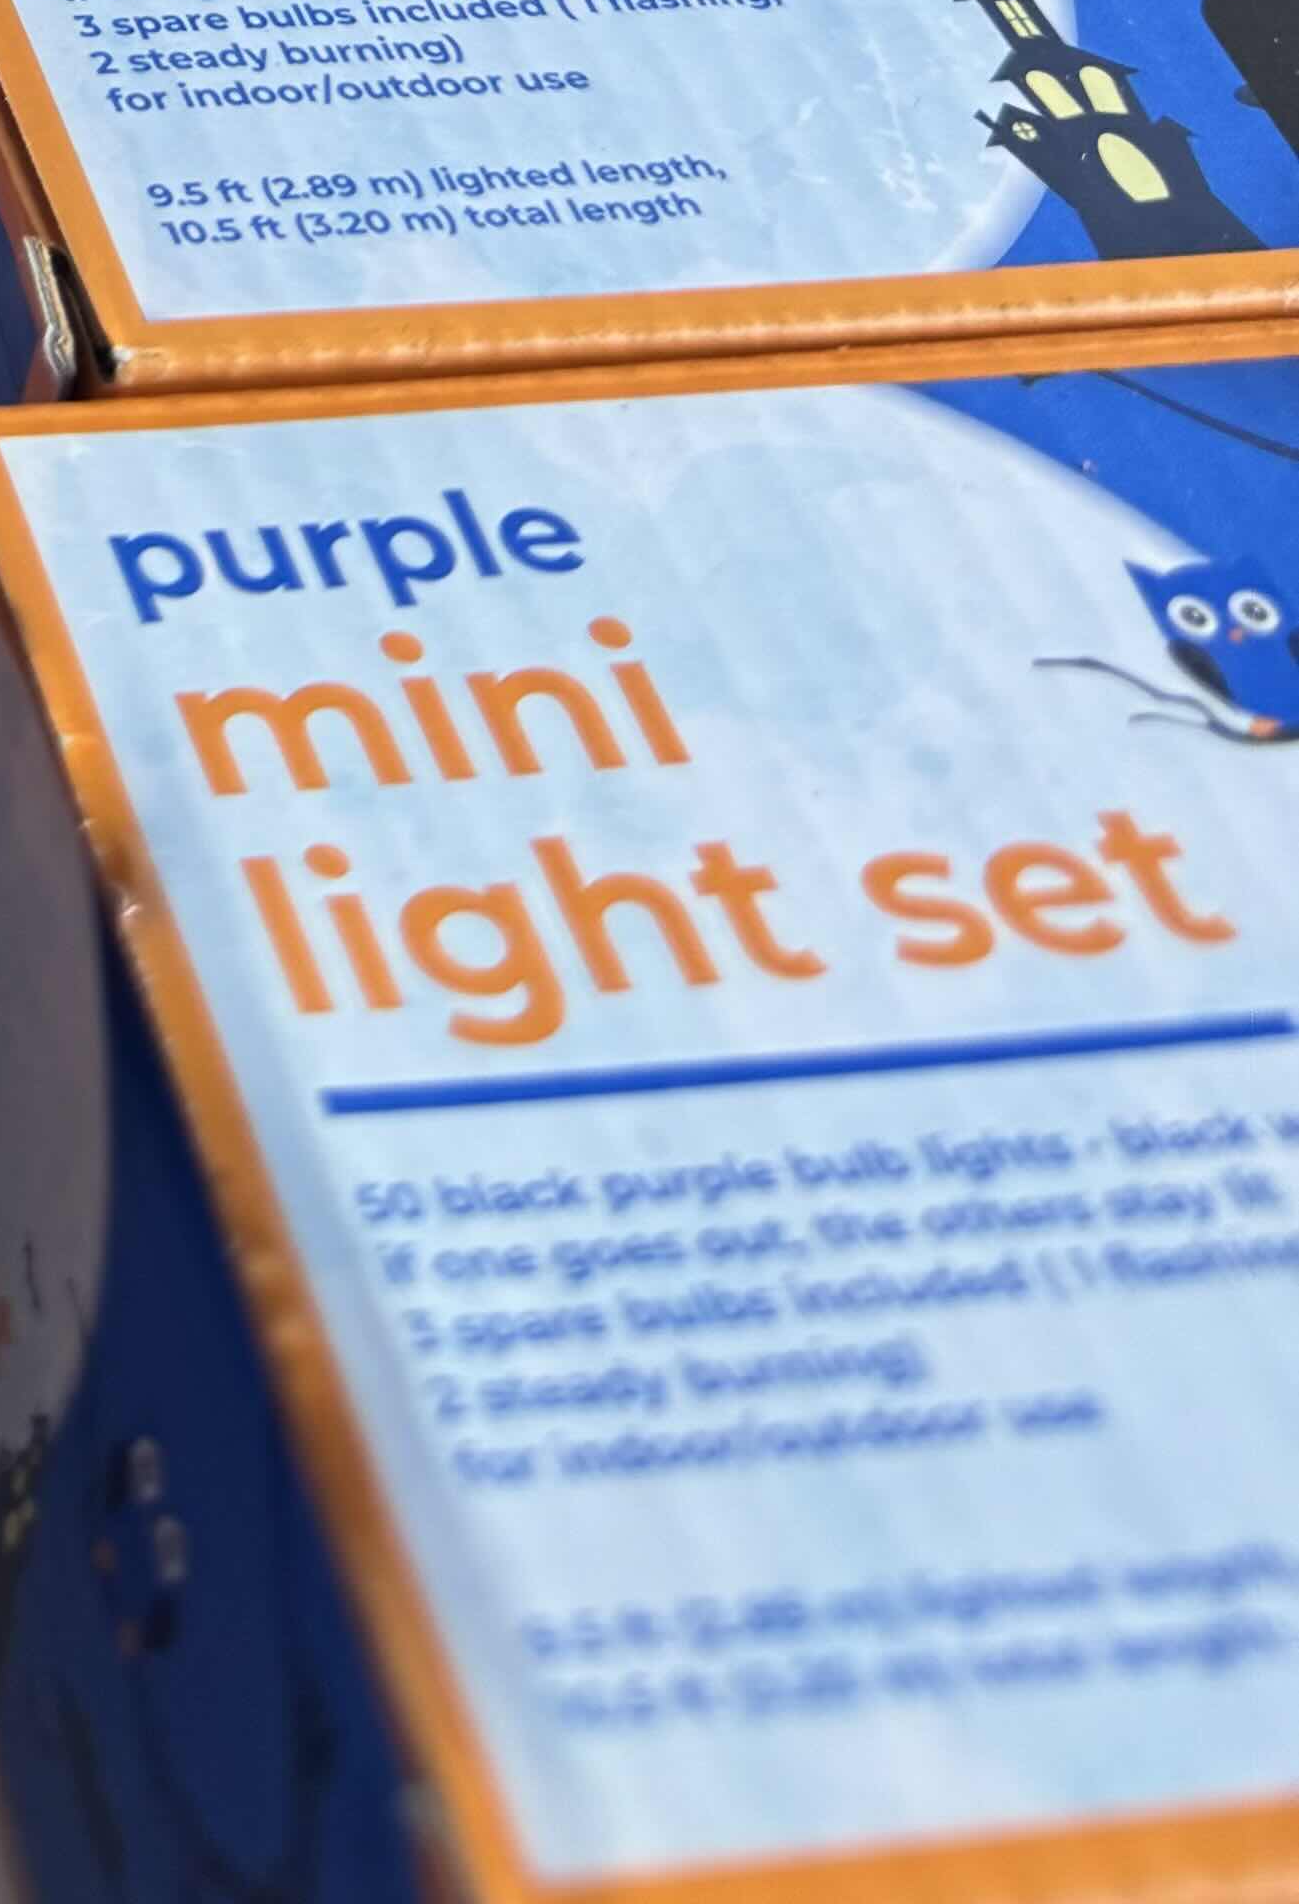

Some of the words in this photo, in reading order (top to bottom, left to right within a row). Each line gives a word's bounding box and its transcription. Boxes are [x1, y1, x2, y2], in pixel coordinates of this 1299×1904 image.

[73, 14, 102, 39] 3
[111, 11, 230, 41] spare
[237, 3, 357, 31] bulbs
[90, 50, 120, 76] 2
[128, 42, 269, 74] steady
[279, 32, 465, 67] burning)
[107, 85, 169, 113] for
[178, 70, 504, 110] indoor/outdoor
[514, 68, 590, 92] use
[147, 180, 210, 208] 9.5
[217, 177, 254, 205] ft
[260, 171, 358, 209] (2.89
[369, 166, 424, 200] m)
[428, 160, 575, 198] lighted
[580, 151, 728, 188] length,
[160, 216, 243, 246] 10.5
[249, 214, 288, 241] ft
[294, 208, 392, 245] (3.20
[401, 203, 459, 237] m)
[463, 198, 562, 229] total
[568, 190, 703, 225] length
[108, 489, 588, 623] purple
[175, 616, 692, 796] mini
[240, 835, 829, 1049] light
[861, 810, 1238, 970] set
[355, 1180, 425, 1226] 50
[432, 1165, 586, 1218] black
[601, 1149, 780, 1214] purple
[783, 1138, 911, 1188] bulb
[915, 1129, 1076, 1183] lights
[1106, 1105, 1258, 1159] black
[431, 1245, 540, 1283] one
[548, 1230, 685, 1283] goes
